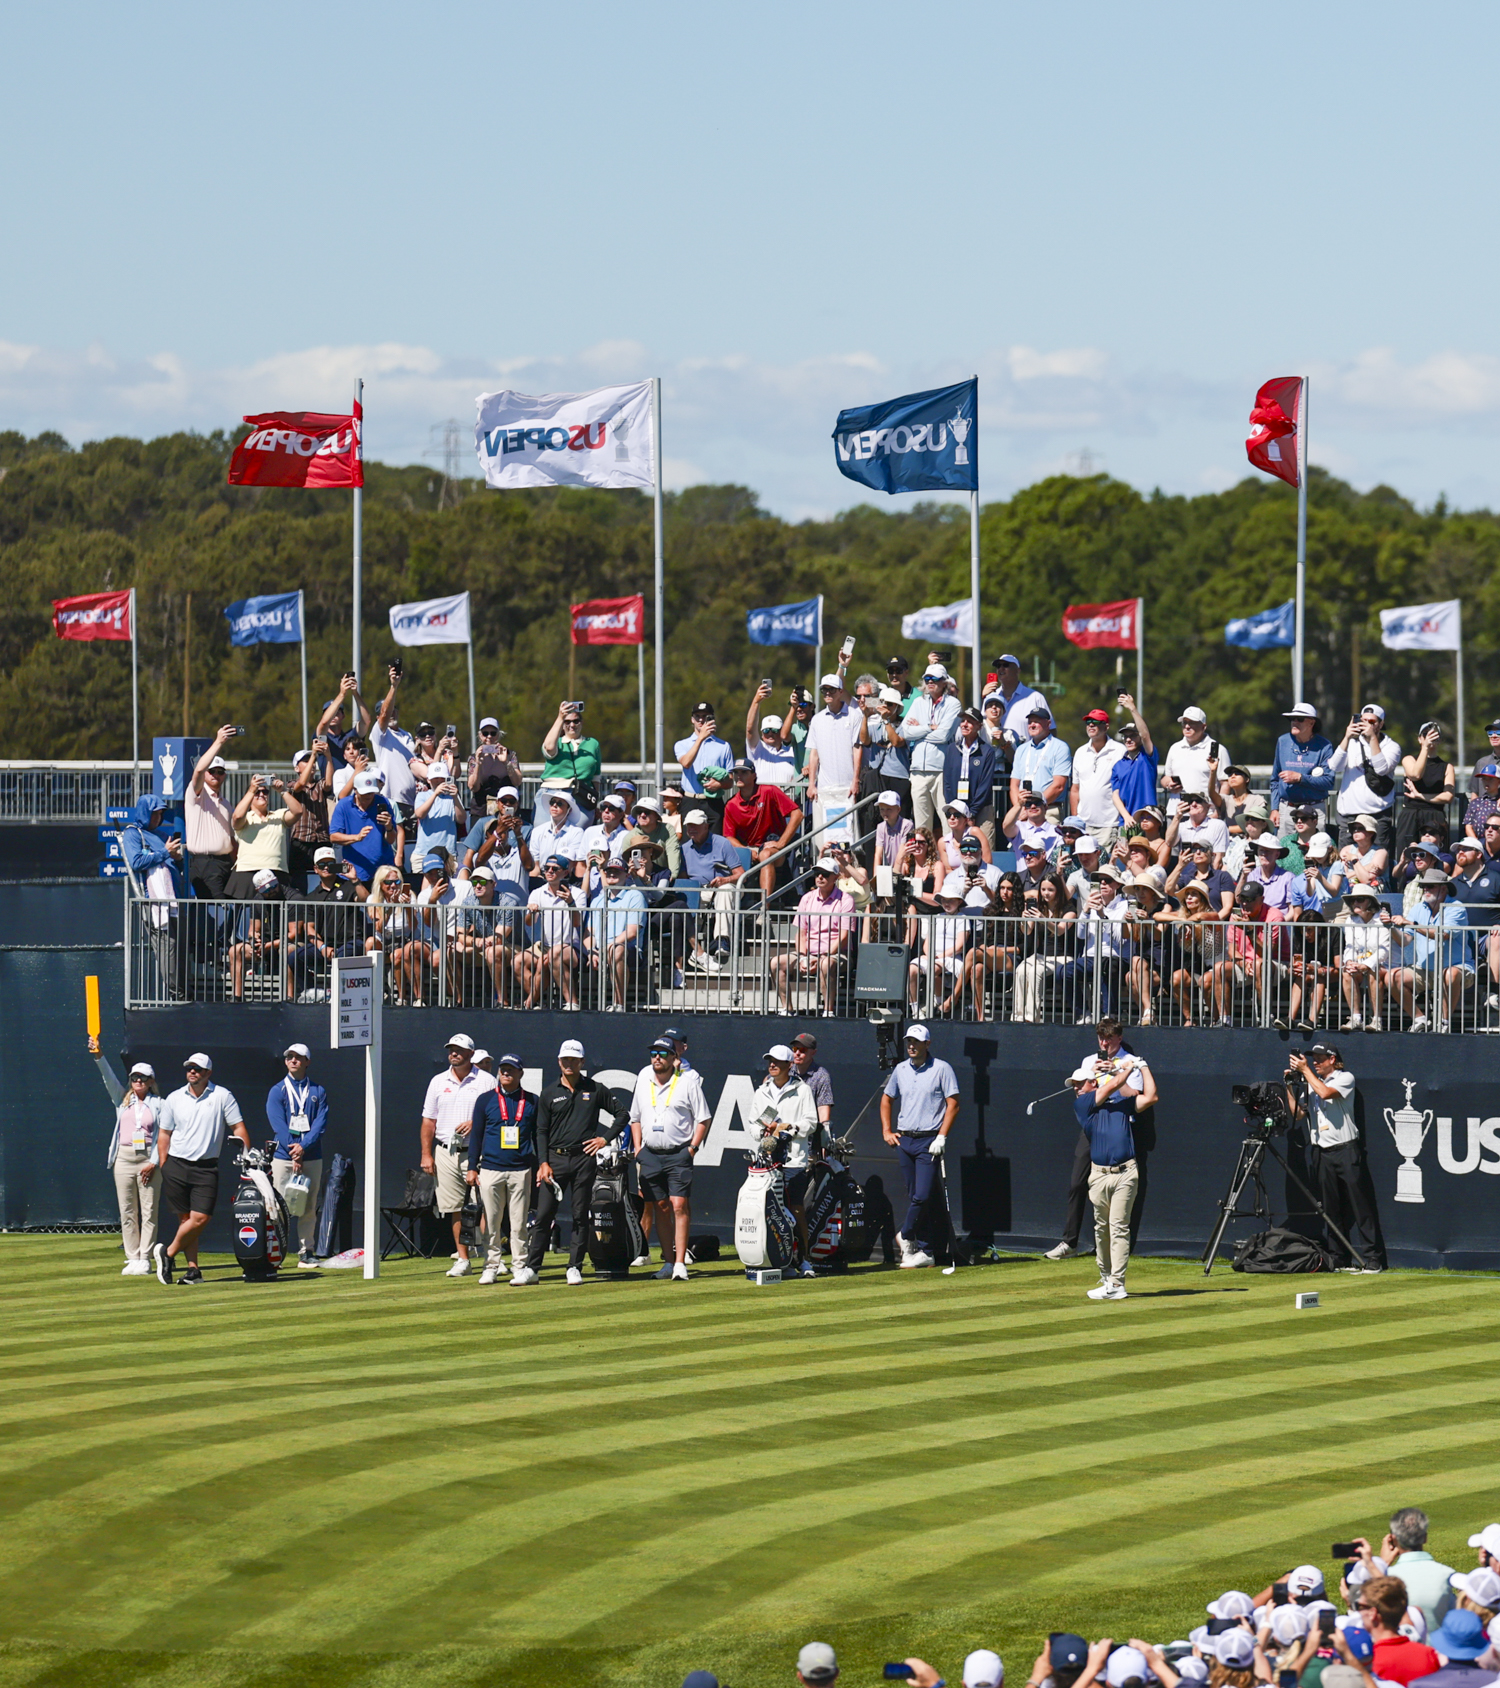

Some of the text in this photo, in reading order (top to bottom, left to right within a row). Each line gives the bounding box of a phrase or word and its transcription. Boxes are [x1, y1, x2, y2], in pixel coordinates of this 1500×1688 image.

[341, 997, 369, 1007] HOLE 10
[341, 1013, 367, 1023] PAR 4
[341, 1030, 355, 1039] YARDS
[742, 1218, 754, 1226] RORY
